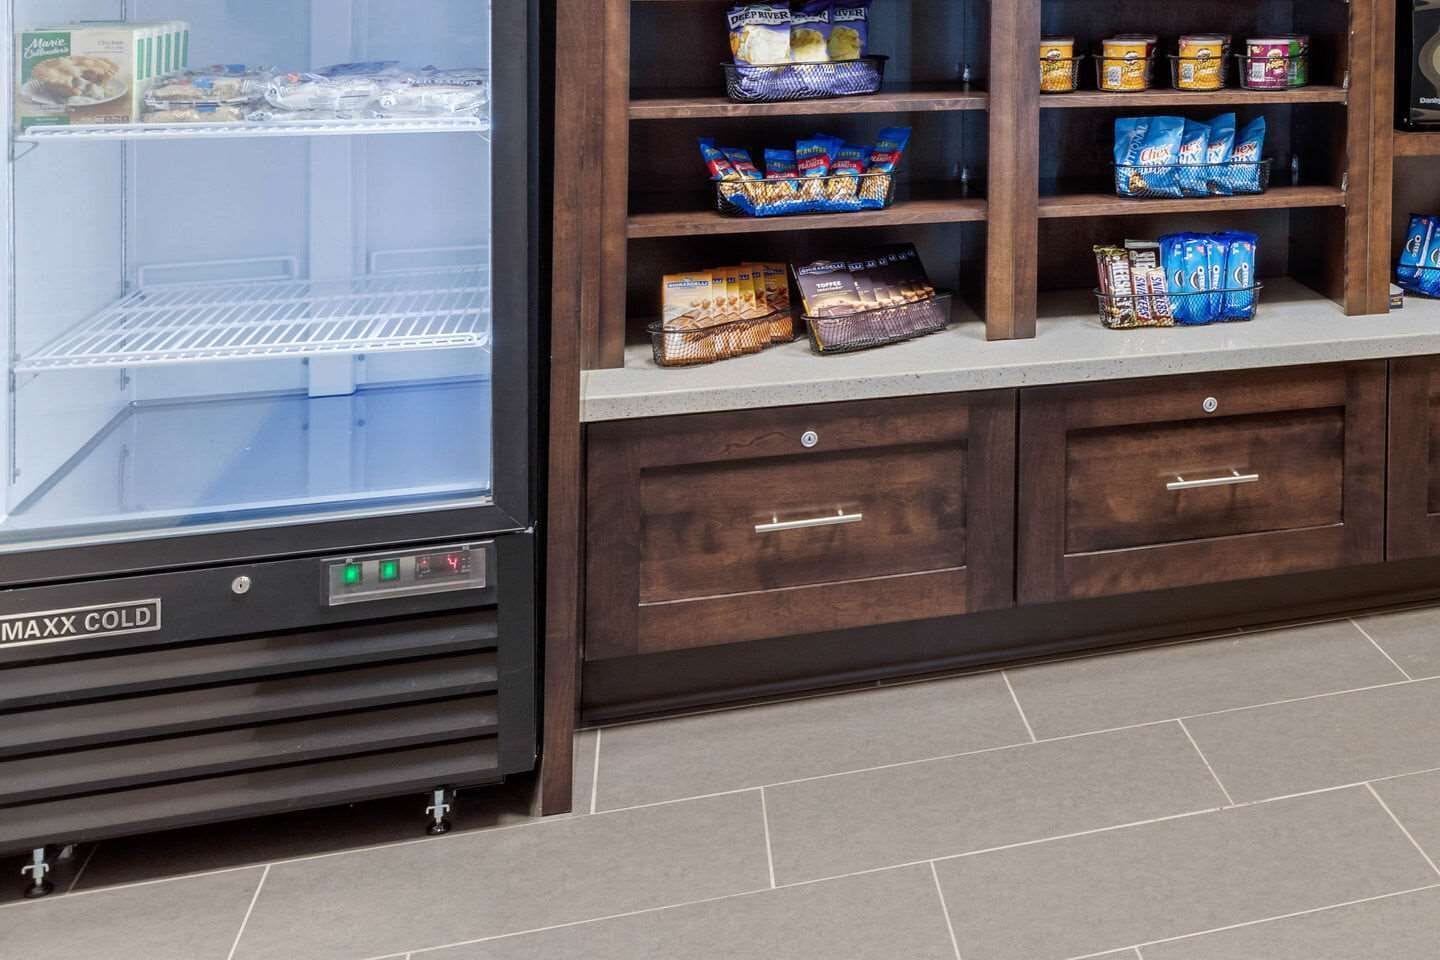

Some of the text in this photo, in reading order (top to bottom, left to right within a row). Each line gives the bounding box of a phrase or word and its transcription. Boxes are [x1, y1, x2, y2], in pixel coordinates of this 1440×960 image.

[731, 11, 789, 25] DEEP RIVER
[837, 8, 864, 17] IVER
[30, 38, 65, 48] Marie
[1140, 147, 1169, 161] Chex
[815, 280, 842, 289] TOFFEE
[1134, 276, 1149, 319] SNICKERS
[1, 606, 151, 642] MAXX COLD
